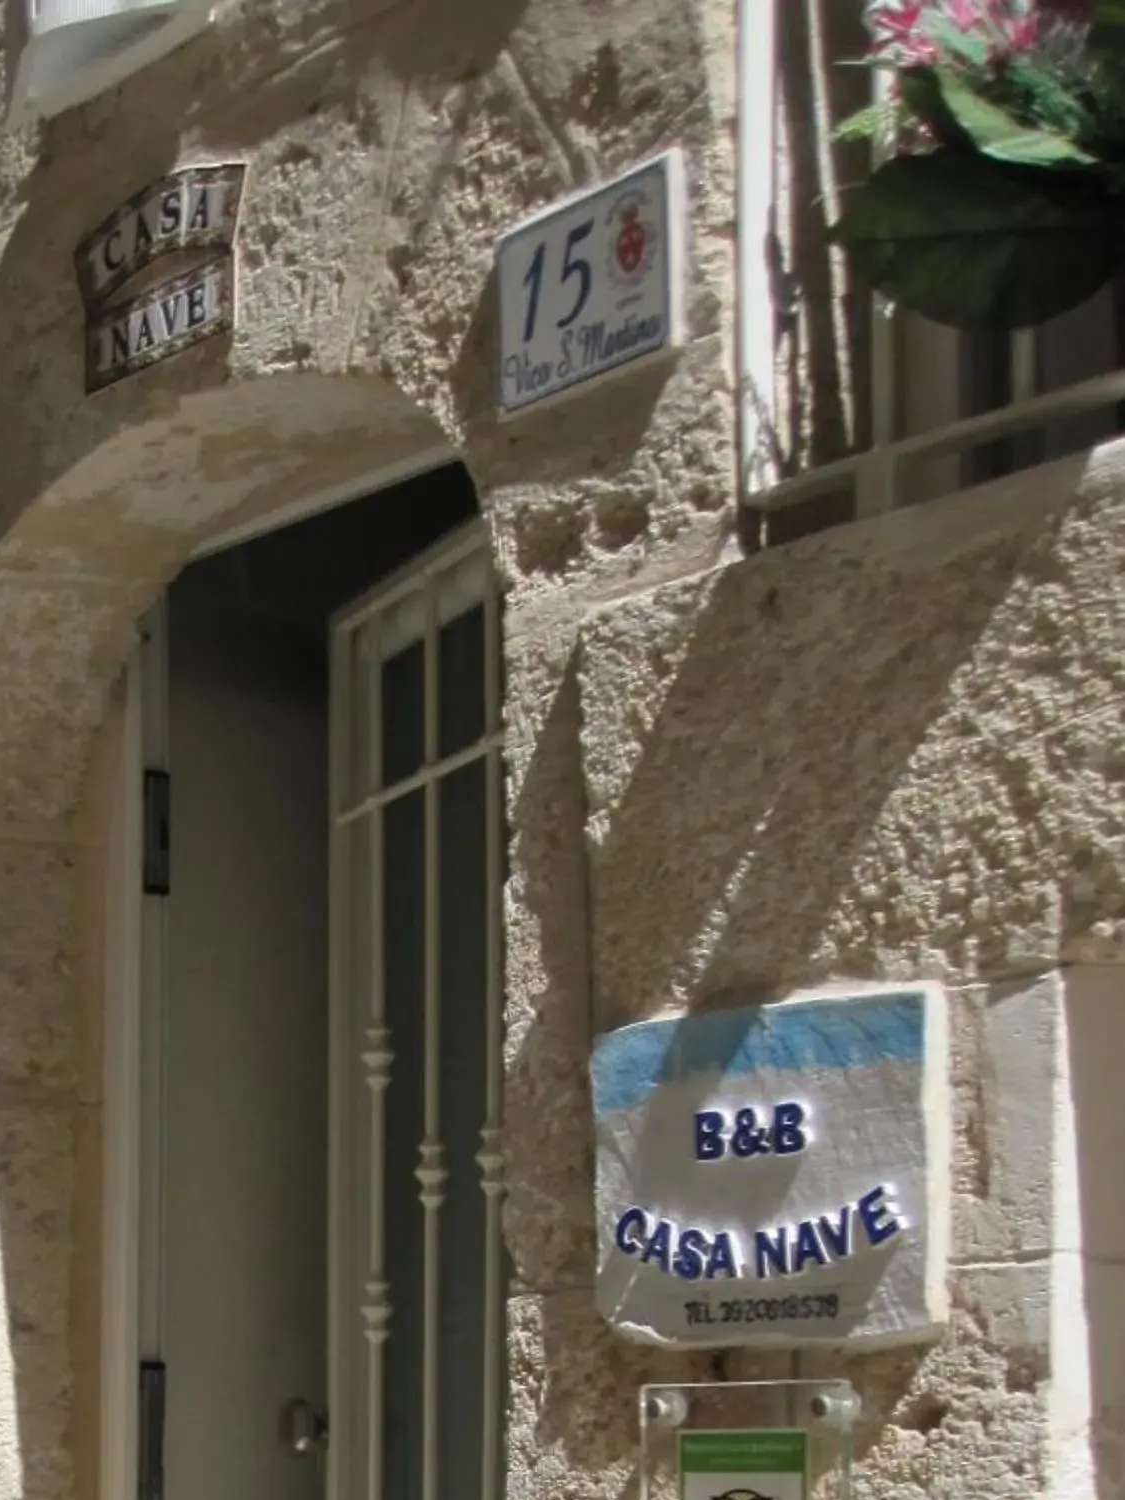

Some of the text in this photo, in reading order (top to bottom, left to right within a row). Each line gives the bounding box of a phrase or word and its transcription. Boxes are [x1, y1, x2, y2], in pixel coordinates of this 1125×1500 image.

[103, 186, 208, 271] CASA
[522, 216, 595, 343] 15
[111, 283, 206, 364] NAVE
[695, 1102, 807, 1160] B&B
[616, 1185, 901, 1280] CASA NAVE
